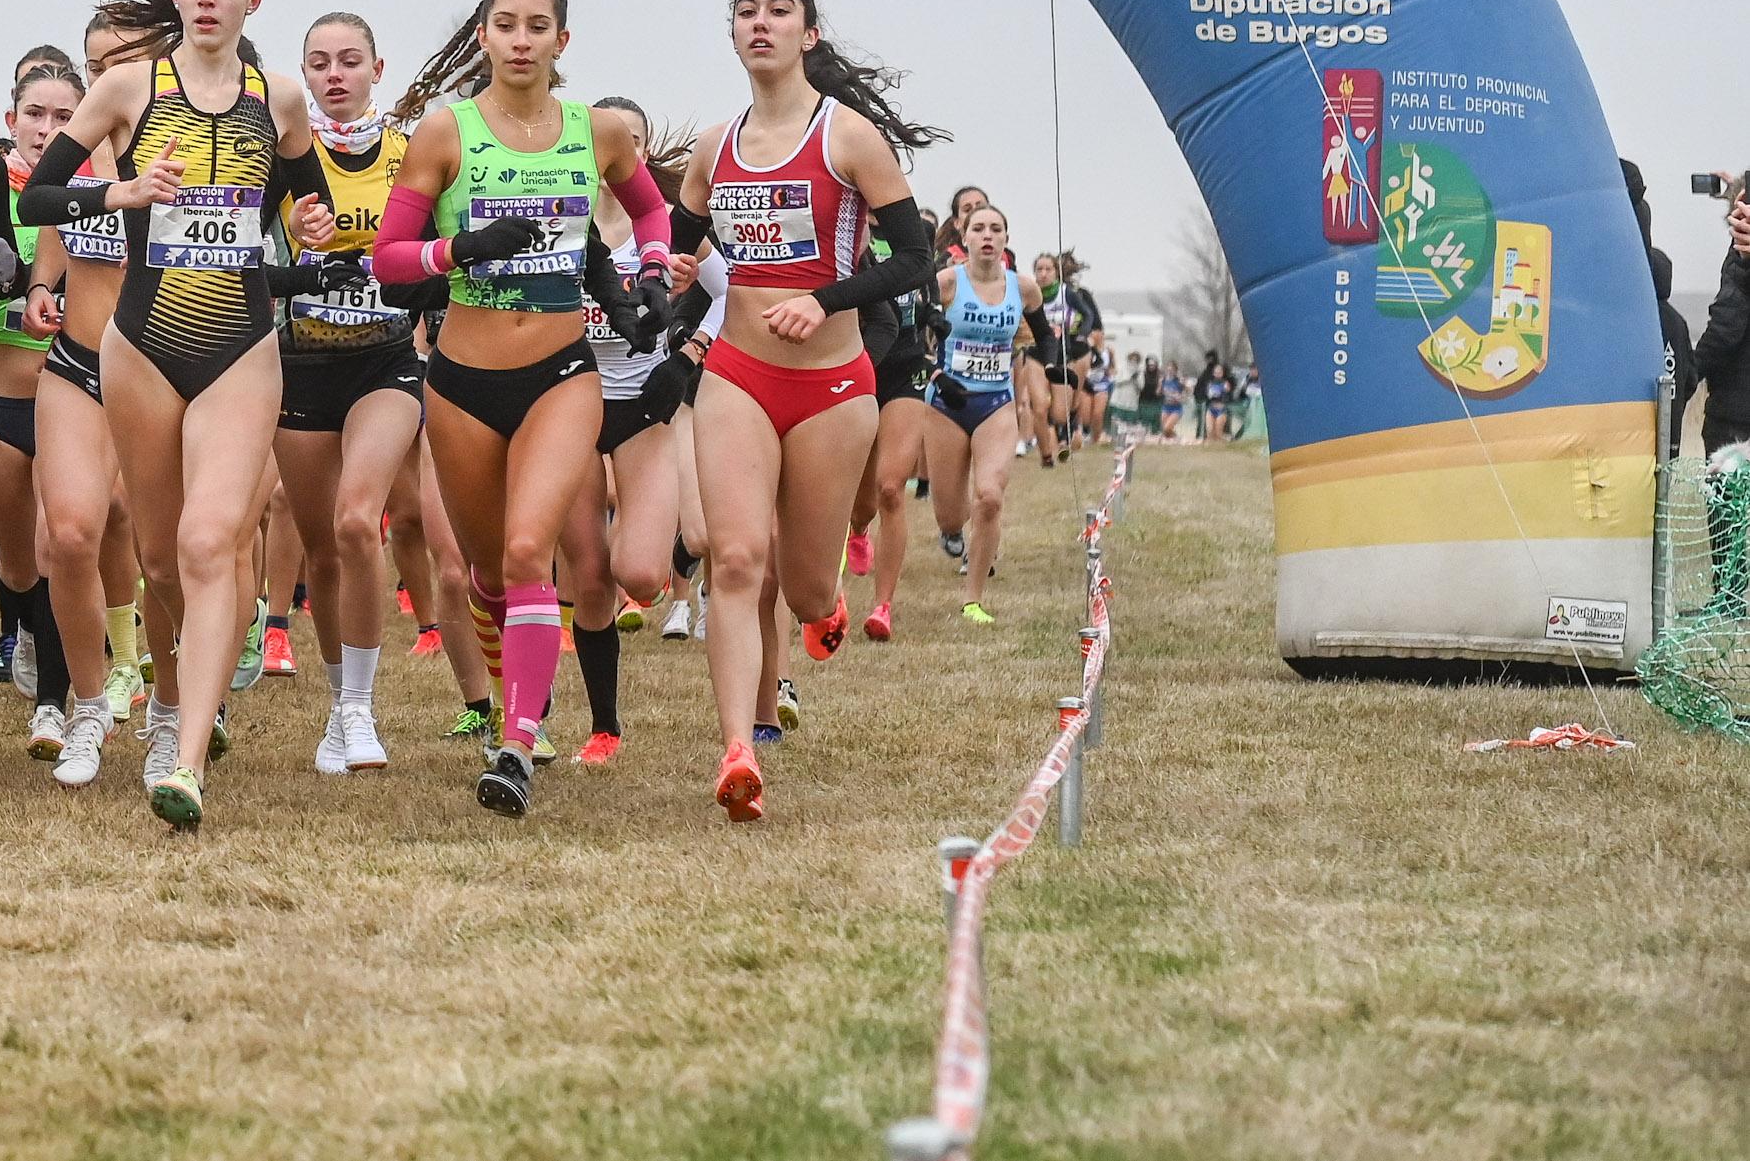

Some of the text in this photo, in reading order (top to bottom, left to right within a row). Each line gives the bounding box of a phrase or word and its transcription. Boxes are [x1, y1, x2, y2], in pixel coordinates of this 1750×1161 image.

[1195, 19, 1389, 48] de Burgos
[1392, 70, 1550, 104] INSTITUTO PROVINCIAL
[1391, 92, 1526, 119] PARA EL DEPORTE
[1390, 114, 1486, 135] Y JUVENTUD
[520, 167, 570, 177] Fundación
[521, 177, 558, 187] Unicaja
[176, 186, 225, 197] PUTACIÓN
[176, 196, 225, 205] URGOS
[484, 198, 544, 208] DIPUTACIÓN
[710, 196, 772, 210] BURGOS
[183, 207, 224, 218] Ibercaja
[335, 208, 380, 231] eik
[484, 207, 544, 217] BURGOS
[730, 211, 763, 221] Ibercaja
[184, 220, 237, 244] 406
[733, 223, 783, 244] 3902
[962, 311, 1015, 328] nerja
[1333, 270, 1351, 386] BURGOS
[966, 359, 1000, 372] 2145
[1570, 605, 1625, 621] Publinews
